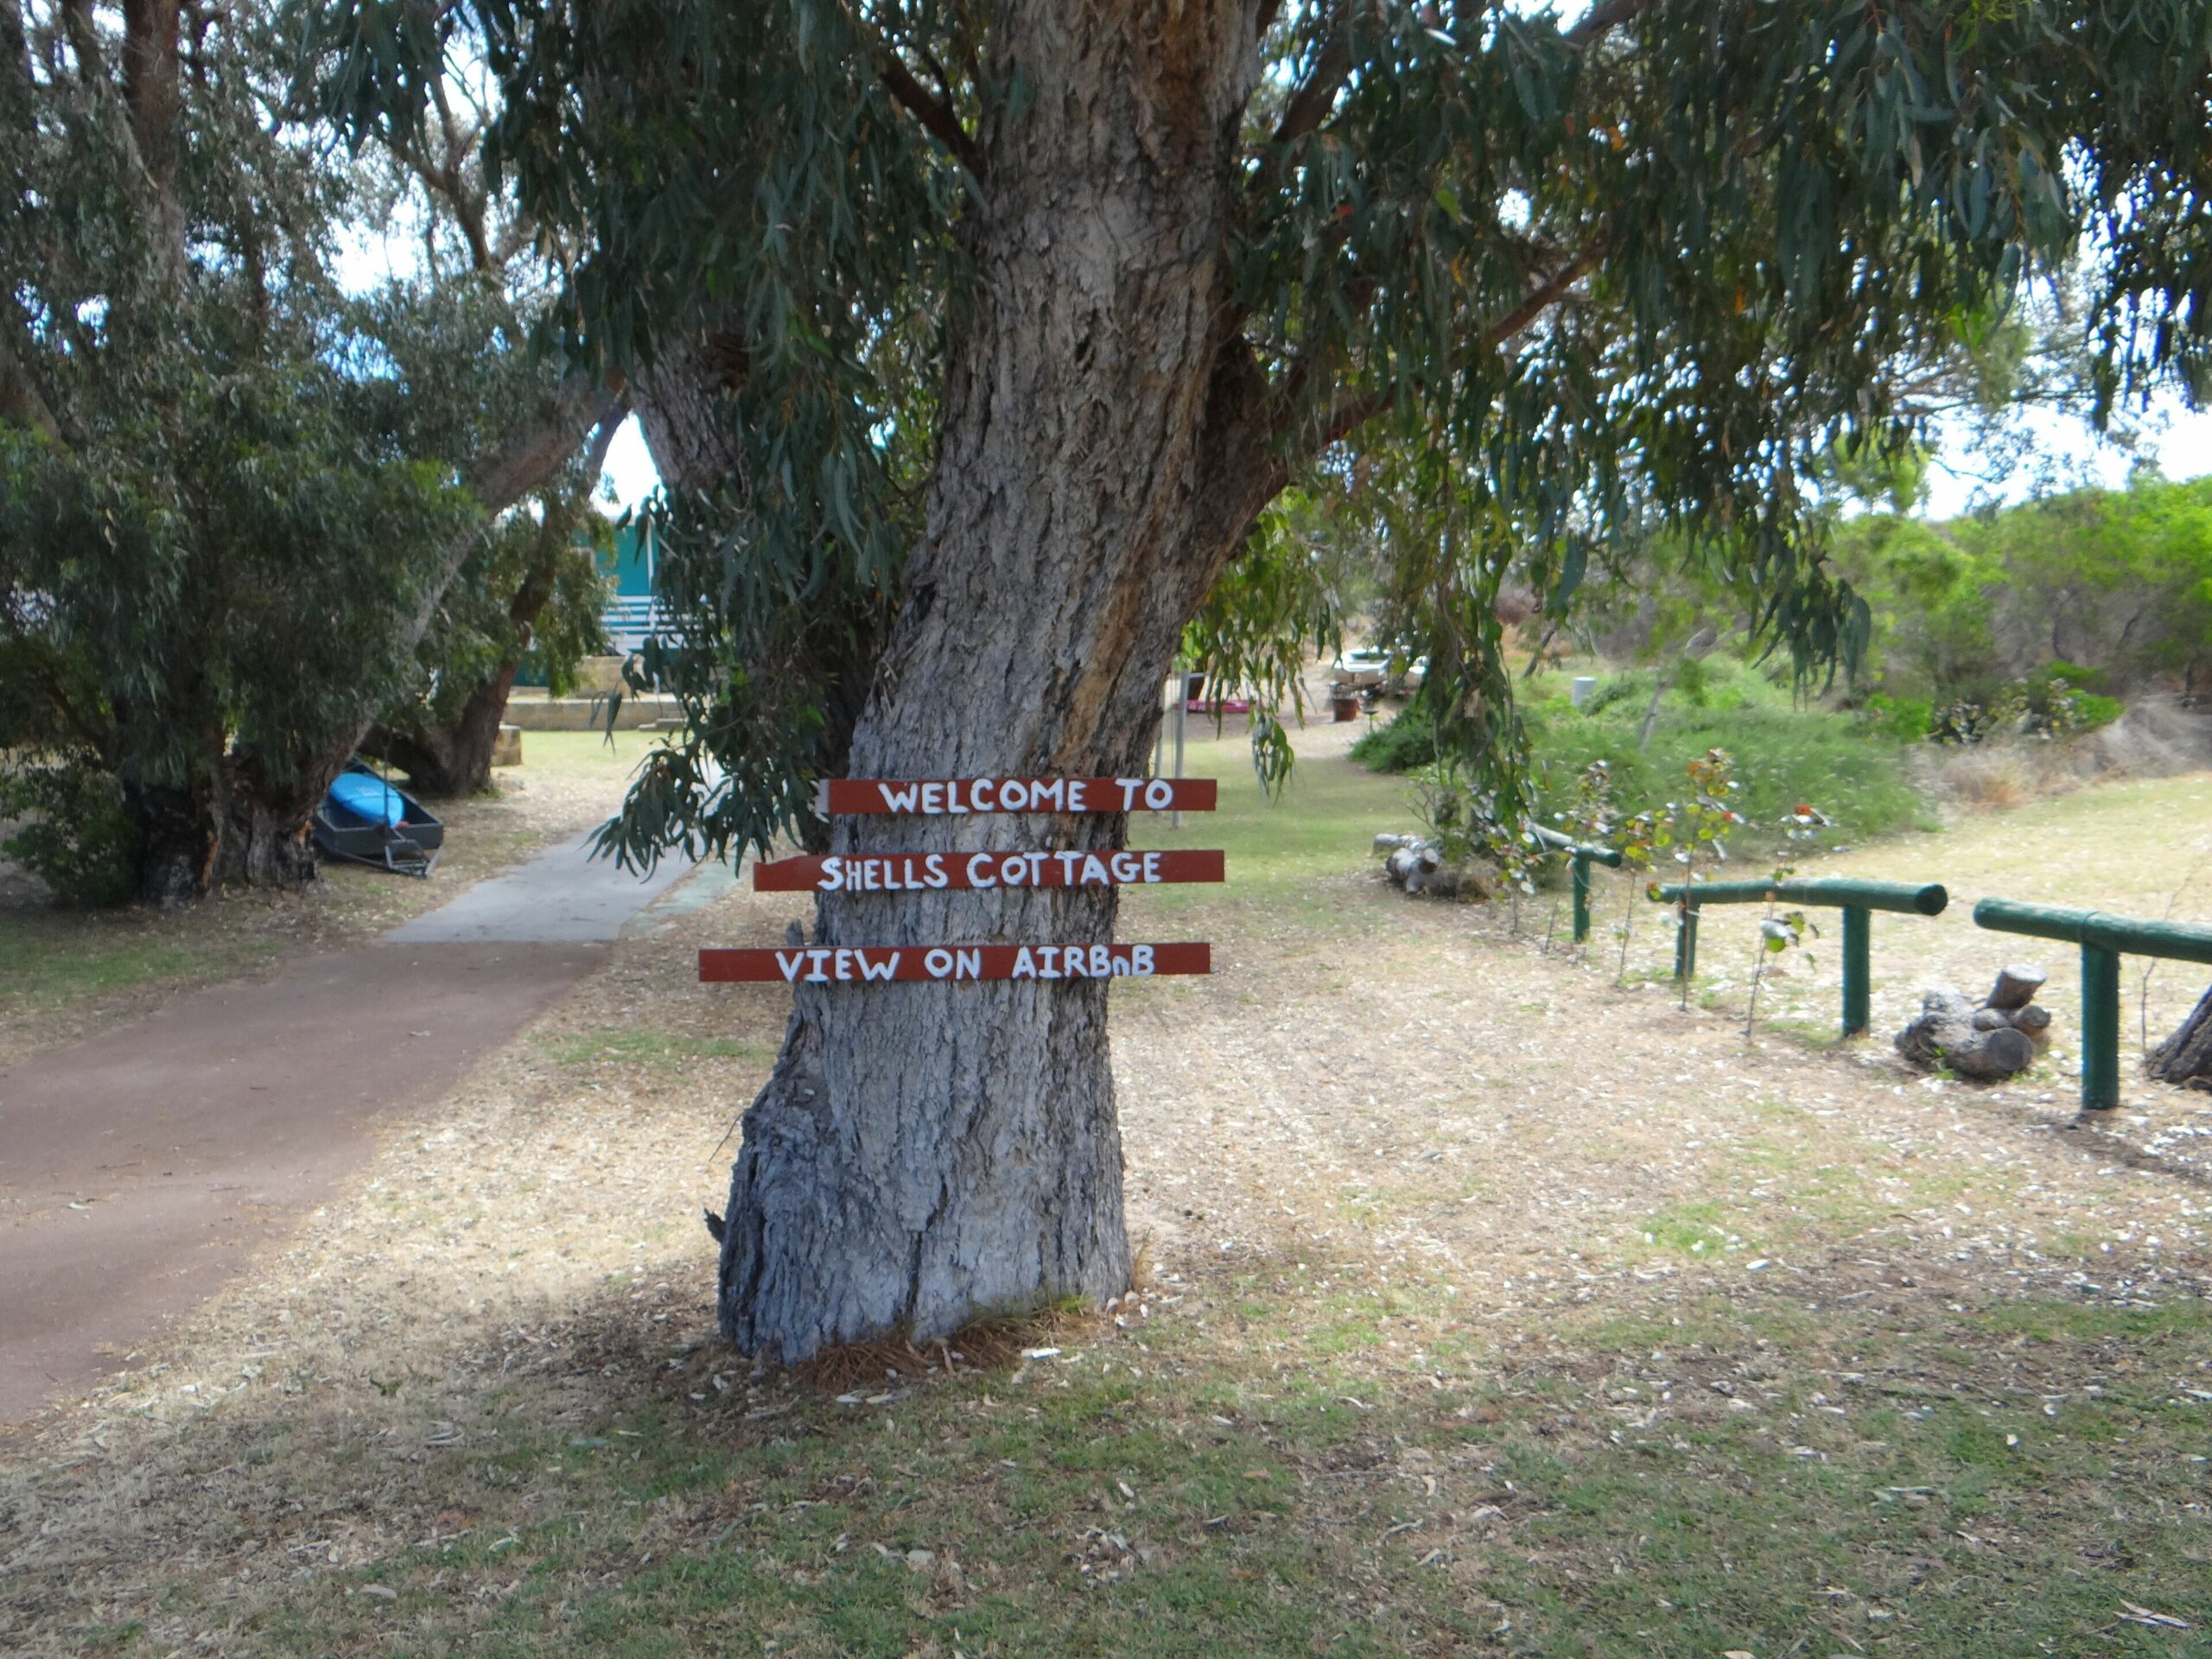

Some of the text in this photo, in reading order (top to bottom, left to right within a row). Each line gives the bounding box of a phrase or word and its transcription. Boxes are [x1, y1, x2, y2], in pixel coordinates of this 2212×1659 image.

[878, 779, 1173, 814] WELCOME TO
[817, 852, 1162, 891] SHELLS COTTAGE
[775, 944, 1155, 982] VIEW ON AIRBnB
